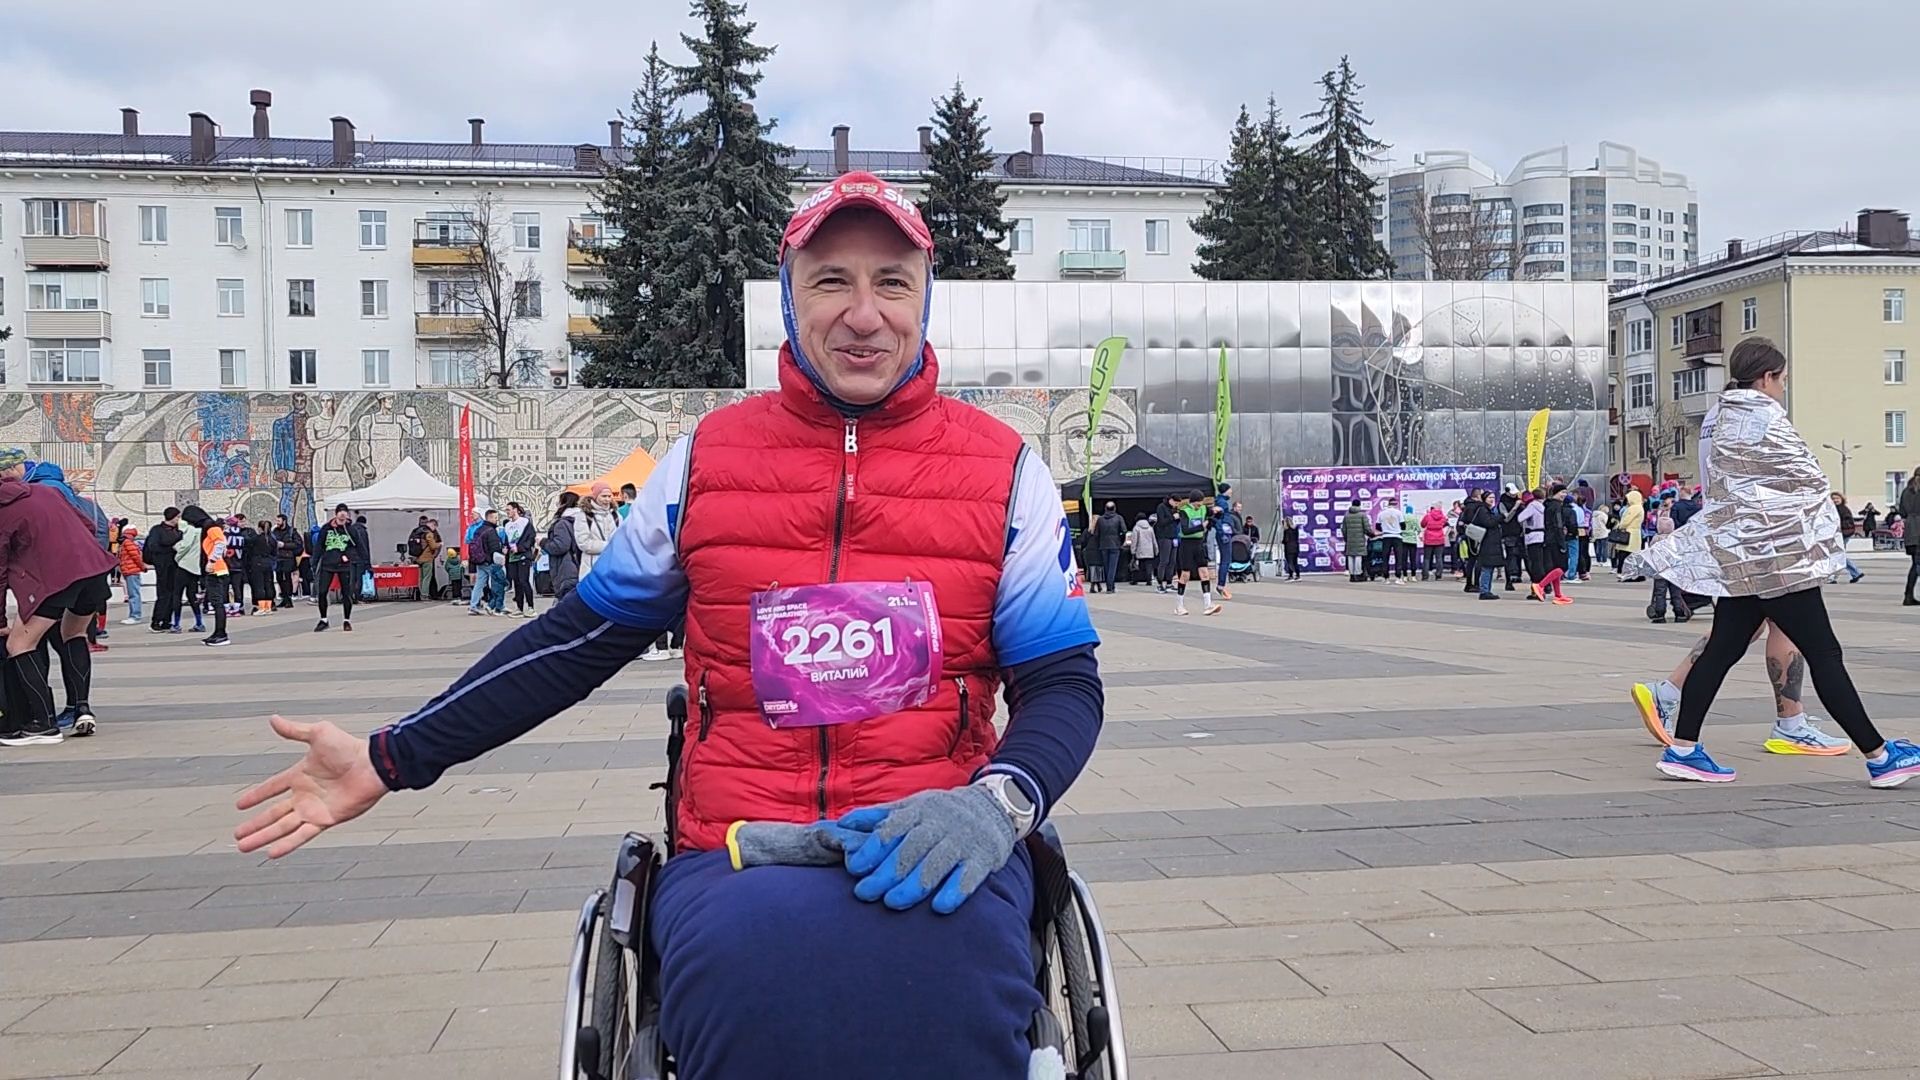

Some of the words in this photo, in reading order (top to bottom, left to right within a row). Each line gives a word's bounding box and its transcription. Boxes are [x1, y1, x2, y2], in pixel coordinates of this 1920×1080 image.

[1313, 474, 1334, 483] AND
[1335, 473, 1367, 483] SPACE
[1369, 473, 1394, 482] HALF
[1396, 472, 1447, 481] MARATHON
[1449, 471, 1497, 480] 13.04.2025
[786, 602, 808, 611] SPACE
[887, 596, 909, 607] 21.1
[773, 609, 808, 619] MARATHON
[781, 616, 894, 666] 2261
[810, 664, 869, 683] ВИТАЛИЙ
